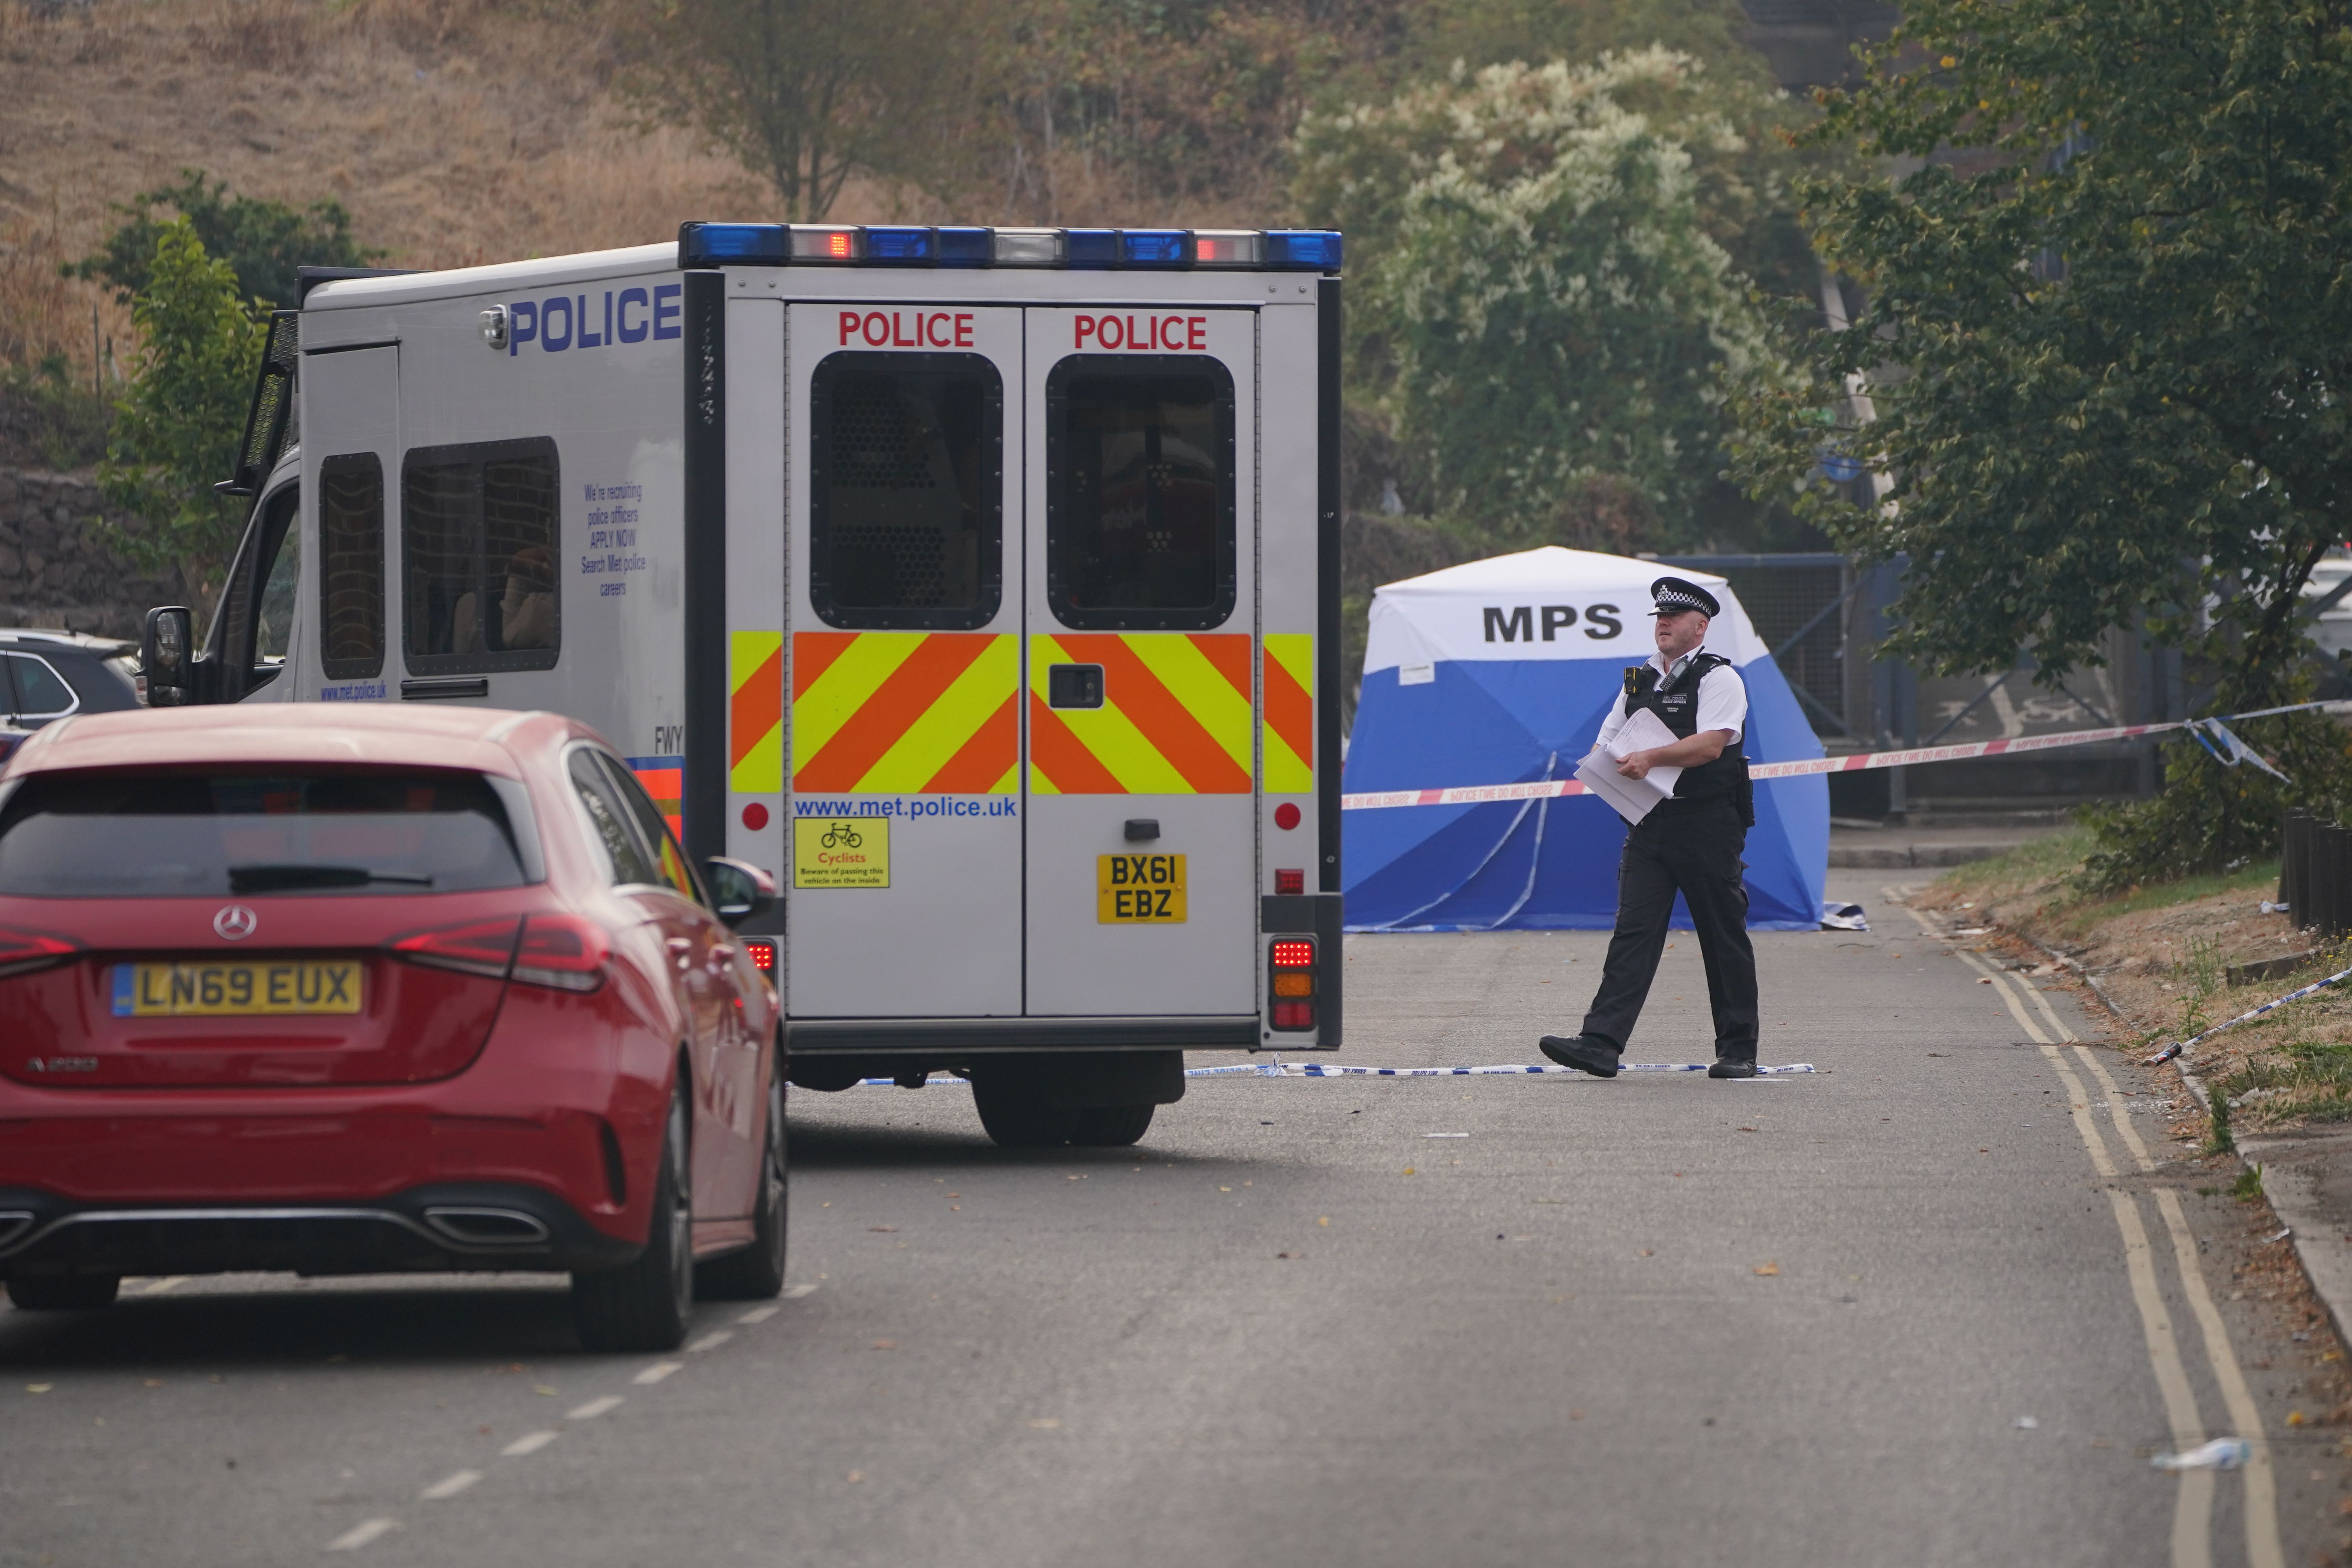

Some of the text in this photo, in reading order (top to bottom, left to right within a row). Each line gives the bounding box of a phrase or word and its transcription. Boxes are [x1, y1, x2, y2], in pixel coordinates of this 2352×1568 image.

[510, 283, 681, 356] POLICE
[839, 312, 973, 347] POLICE
[1074, 315, 1206, 350] POLICE
[584, 481, 642, 503] We're recruiting
[588, 505, 638, 529] police officers
[590, 529, 636, 549] APPLY NOW
[581, 553, 645, 575] Search Met police
[600, 583, 626, 597] careers
[1483, 604, 1622, 643] MPS
[321, 680, 386, 702] www.met.police.uk
[655, 726, 683, 755] FWY
[795, 797, 1016, 820] www.met.police.uk
[818, 852, 866, 866] Cyclists
[1111, 856, 1175, 884] BX61
[840, 868, 867, 876] passing
[1116, 889, 1172, 918] EBZ
[141, 967, 350, 1006] LN69 EUX
